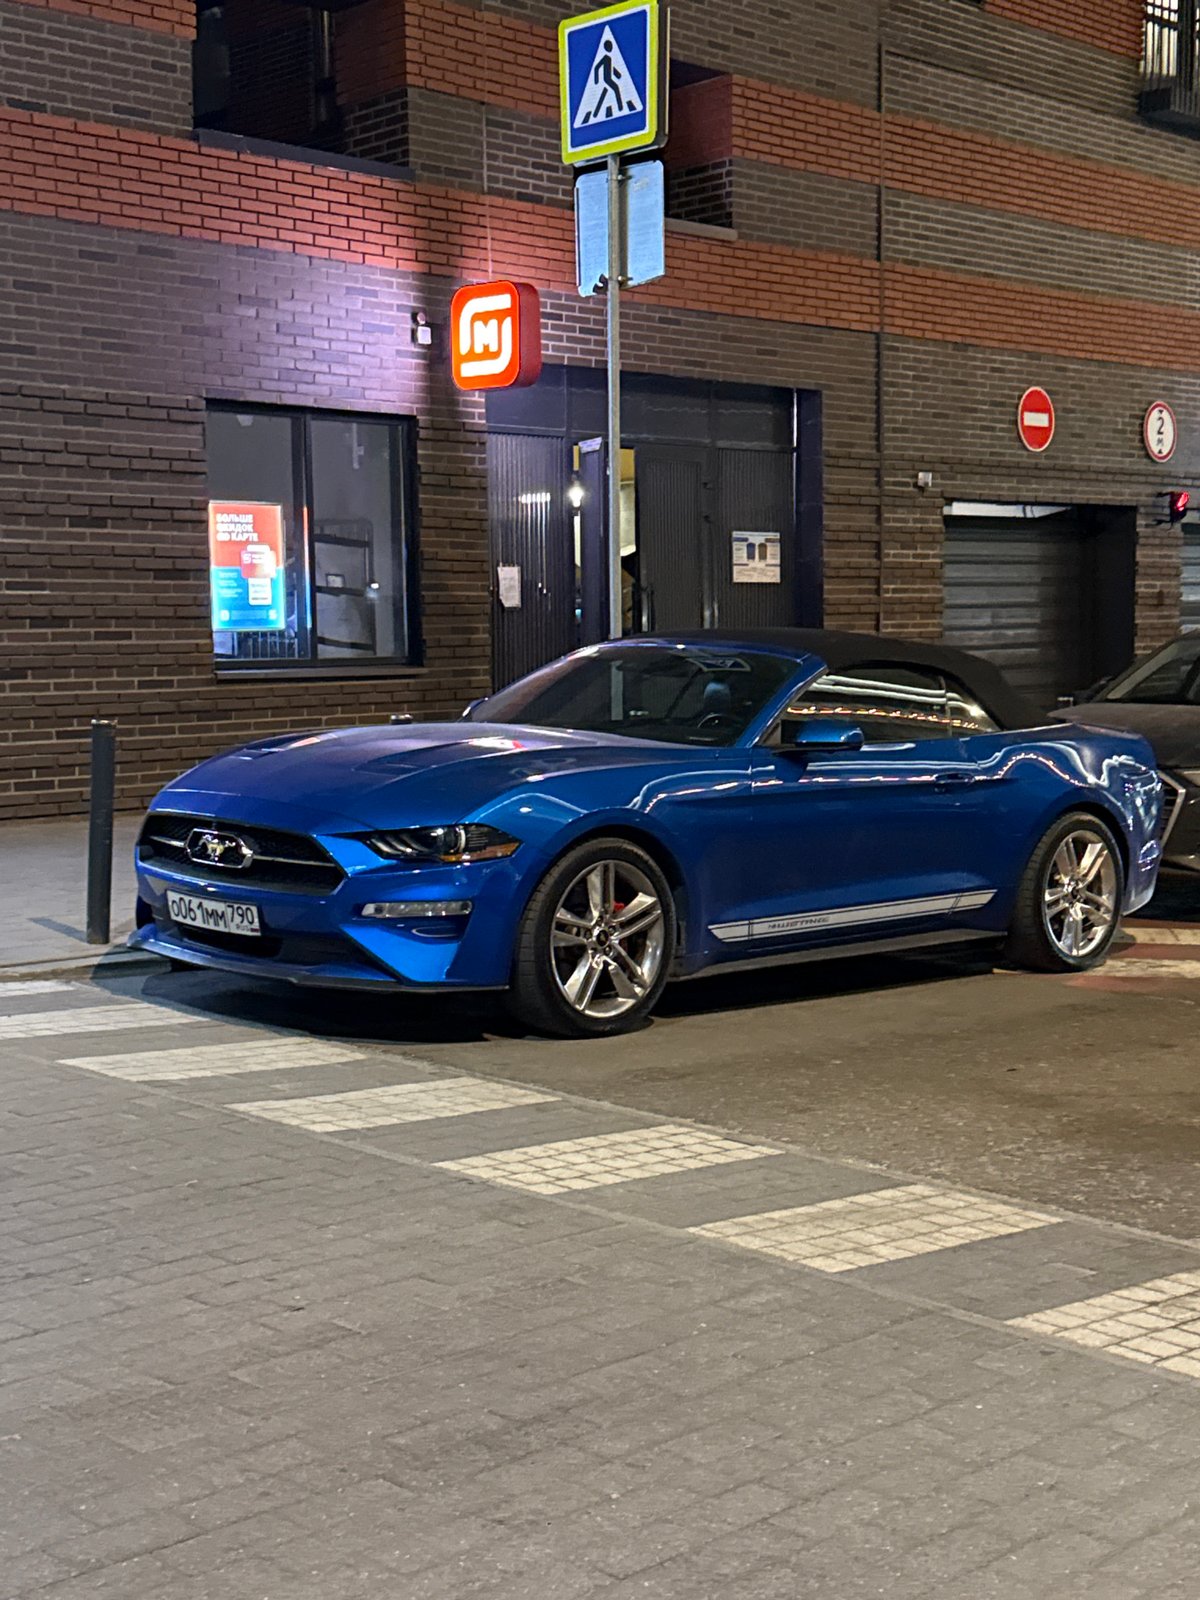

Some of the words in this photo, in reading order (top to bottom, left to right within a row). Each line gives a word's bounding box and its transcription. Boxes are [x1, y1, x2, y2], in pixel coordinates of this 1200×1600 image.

[1157, 417, 1164, 435] 2
[216, 513, 253, 523] БОЛЬШЕ
[231, 533, 258, 541] КАРТЕ
[227, 904, 255, 925] 790
